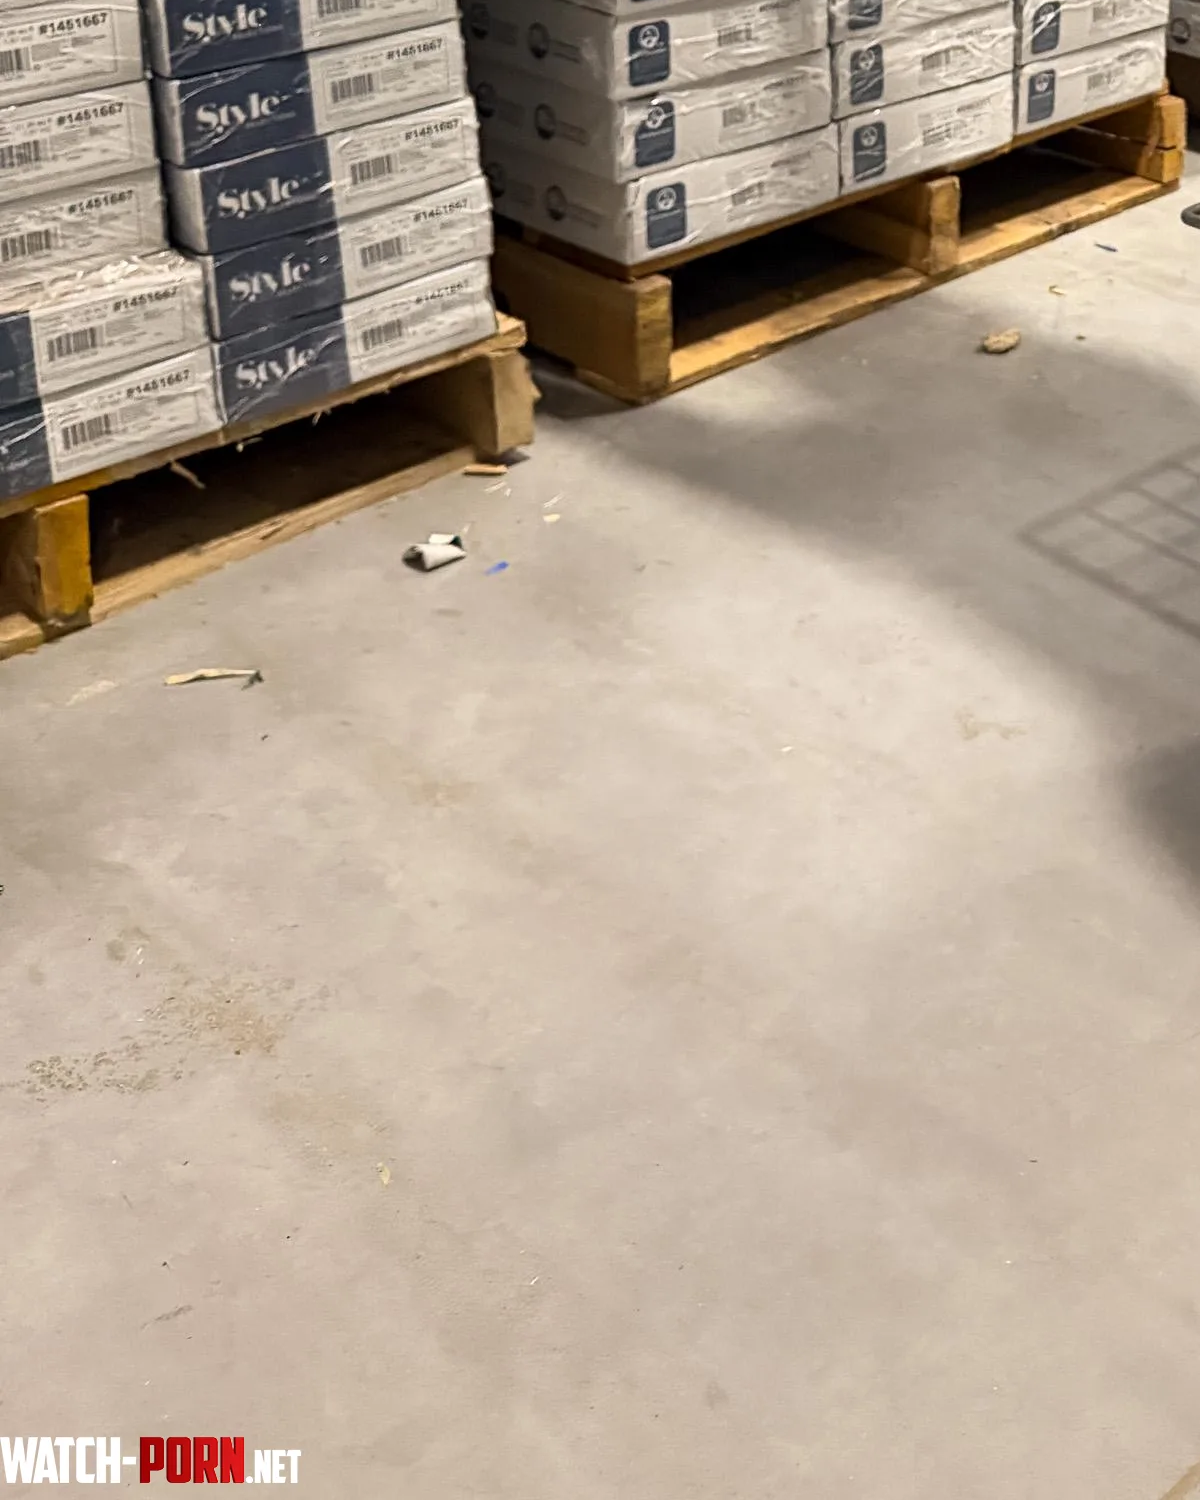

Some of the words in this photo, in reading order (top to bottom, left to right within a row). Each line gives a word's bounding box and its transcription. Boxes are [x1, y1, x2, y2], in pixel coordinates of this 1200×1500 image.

[39, 12, 108, 35] #1451667
[181, 3, 268, 45] Style
[386, 38, 443, 60] #1451667
[57, 101, 124, 126] #1451667
[195, 92, 280, 136] Style
[217, 176, 299, 220] Style
[228, 259, 311, 302] Style
[126, 368, 191, 398] #1451667
[235, 347, 316, 391] Style
